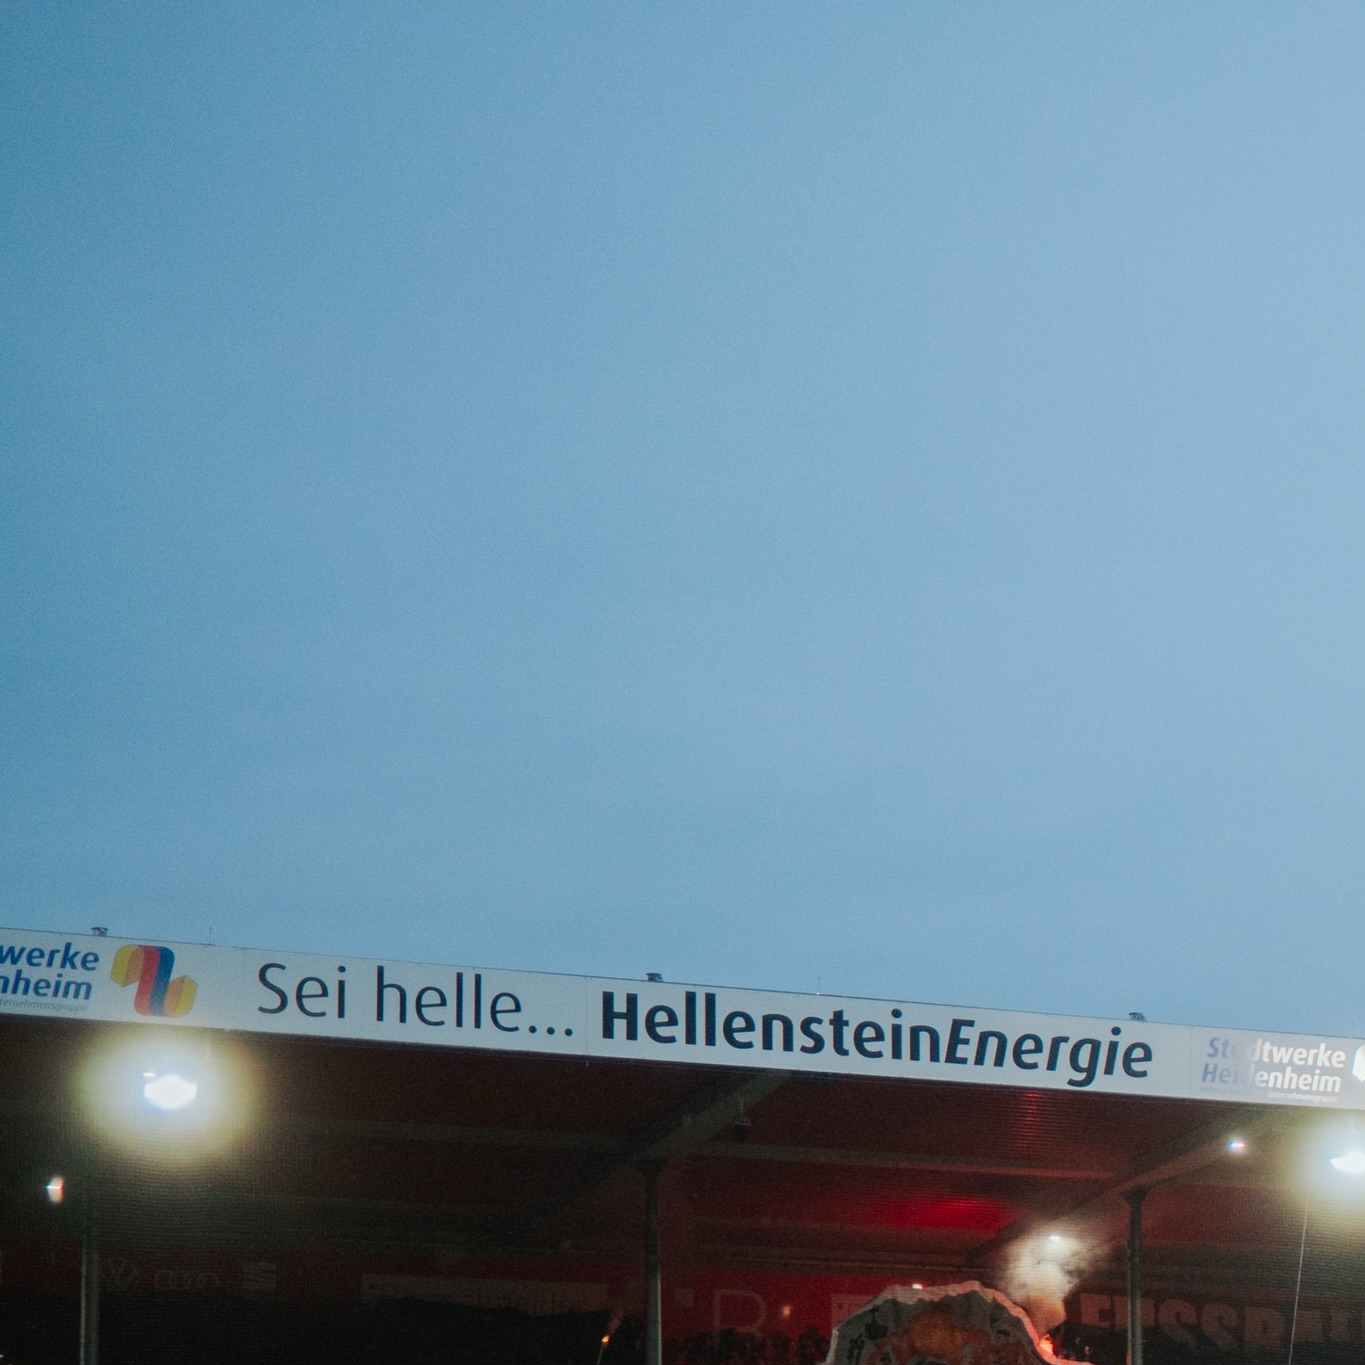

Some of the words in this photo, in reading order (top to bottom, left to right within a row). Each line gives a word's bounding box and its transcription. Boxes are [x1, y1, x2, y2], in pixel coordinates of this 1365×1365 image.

[257, 962, 347, 1019] Sei
[376, 965, 574, 1037] helle...
[601, 990, 1154, 1088] HellensteinEnergie
[1207, 1037, 1347, 1069] Stadtwerke
[1201, 1062, 1342, 1093] Heidenheim
